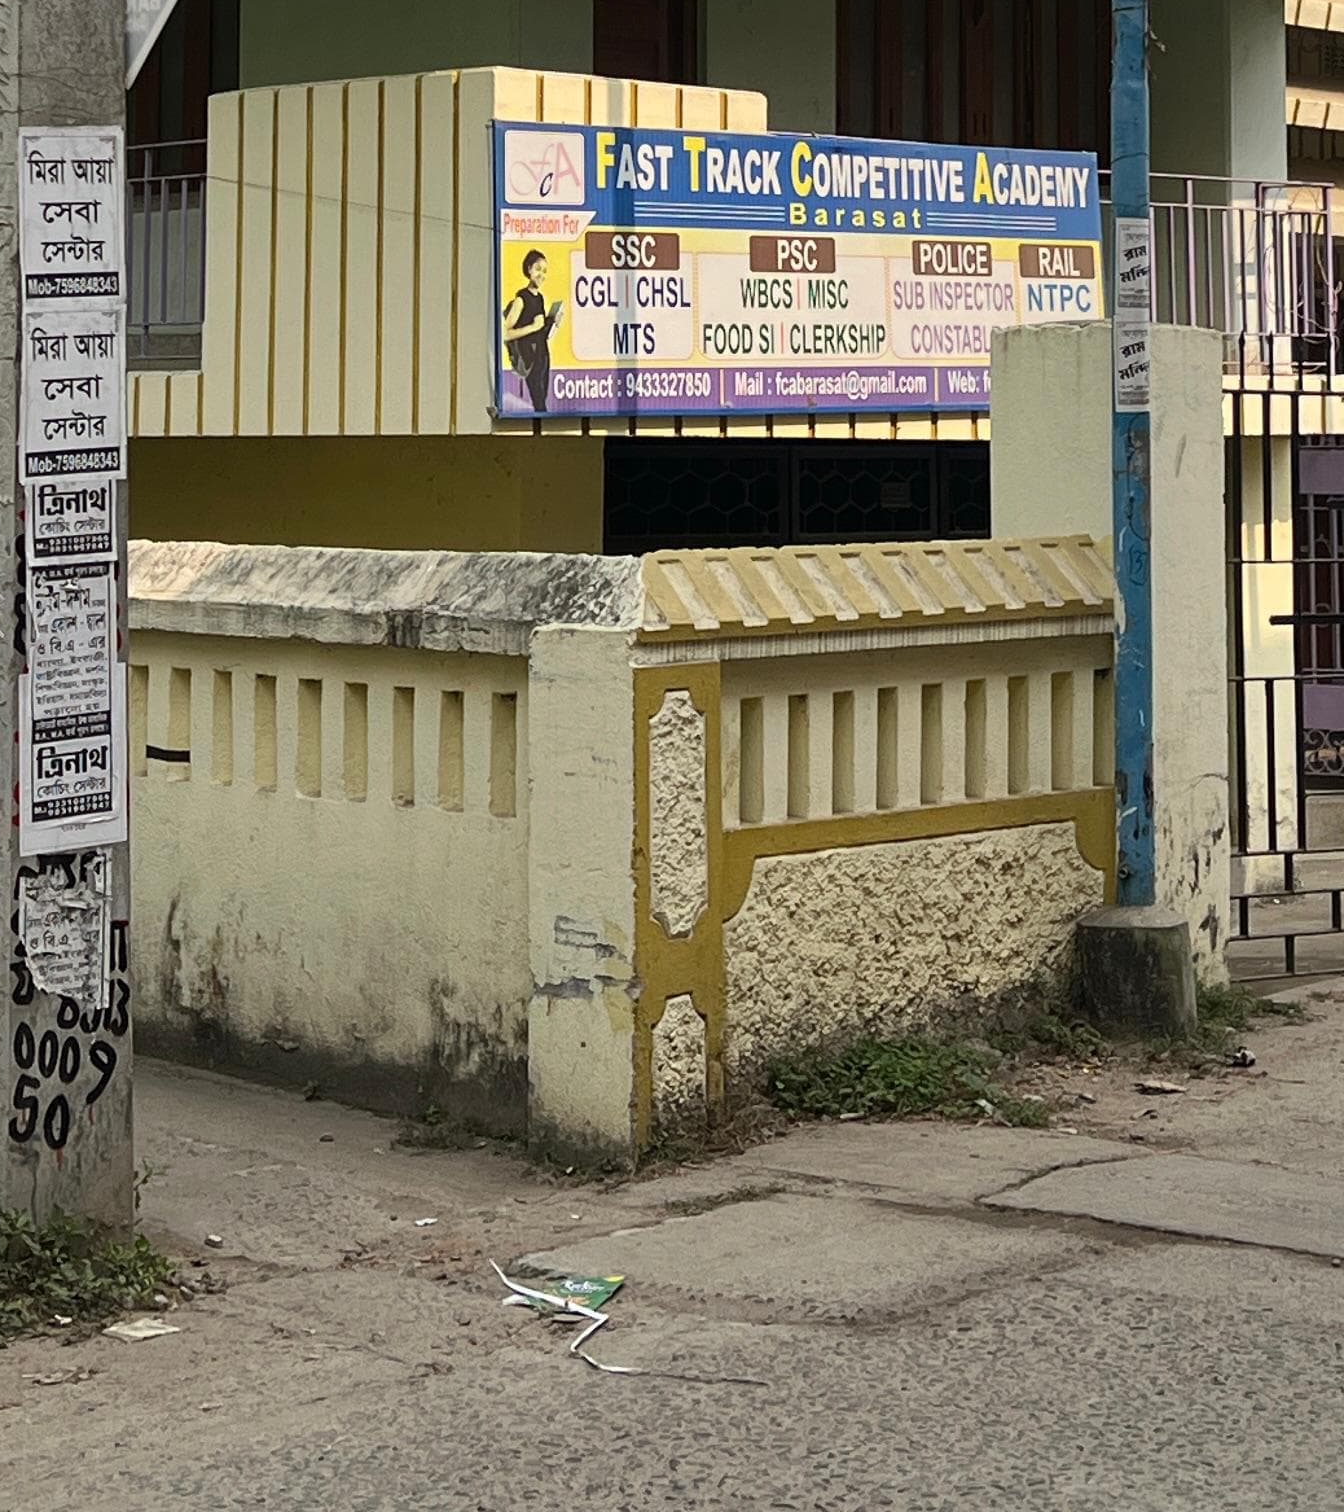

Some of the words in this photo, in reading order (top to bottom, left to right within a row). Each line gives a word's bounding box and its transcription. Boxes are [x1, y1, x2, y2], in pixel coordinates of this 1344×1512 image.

[27, 150, 66, 185] মিরা
[71, 155, 114, 186] আয়া
[595, 131, 674, 191] FAST
[683, 136, 782, 196] TRACK
[790, 141, 965, 202] COMPETITIVE
[972, 152, 1090, 208] ACADEMY
[40, 199, 102, 224] সেবা
[503, 213, 561, 237] Preparation
[563, 215, 580, 234] For
[789, 202, 922, 230] Barasat
[41, 234, 106, 264] সেন্টার
[610, 234, 657, 268] SSC
[776, 239, 818, 271] PSC
[919, 242, 990, 275] POLICE
[1037, 246, 1081, 277] RAIL
[575, 275, 619, 308] CGL
[636, 276, 691, 308] CHSL
[740, 278, 793, 310] WBCS
[807, 279, 849, 309] MISC
[893, 279, 925, 310] SUB
[929, 281, 1014, 312] INSPECTOR
[1027, 283, 1091, 313] NTPC
[30, 327, 68, 361] মিরা
[74, 332, 116, 360] আয়া
[612, 322, 656, 355] MTS
[703, 323, 753, 354] FOOD
[758, 323, 775, 354] SI
[789, 323, 886, 354] CLERKSHIP
[911, 324, 991, 353] CONSTABL
[42, 375, 103, 401] সেবা
[553, 373, 613, 399] Contact
[626, 372, 712, 397] 9433327850
[734, 372, 764, 396] Mail
[775, 370, 928, 400] fcabarasat@gmail.com
[947, 370, 980, 394] Web:
[42, 410, 107, 440] সেন্টার
[38, 484, 107, 516] ত্রিনাথ
[36, 745, 108, 780] ত্রিনাথ
